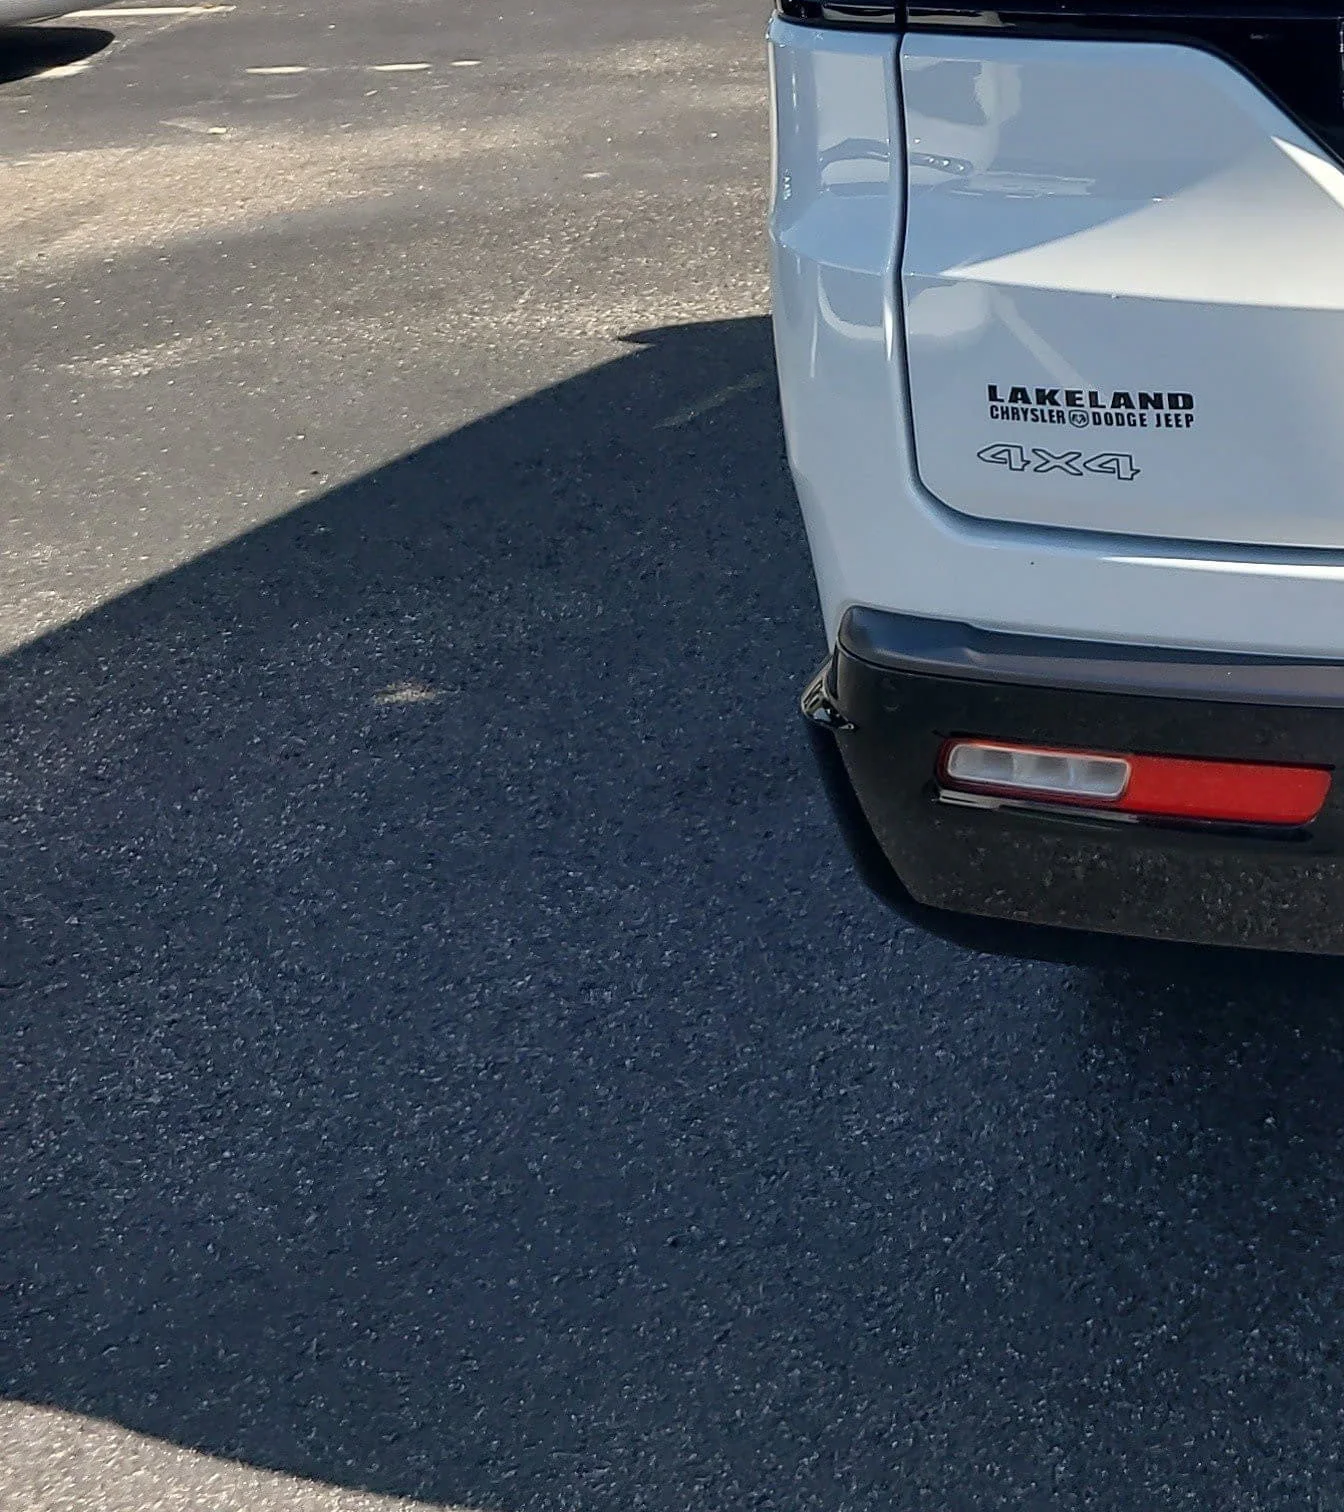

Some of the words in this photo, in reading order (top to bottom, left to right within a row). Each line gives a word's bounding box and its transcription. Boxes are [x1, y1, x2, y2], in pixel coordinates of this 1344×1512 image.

[987, 384, 1195, 411] LAKELAND
[990, 405, 1067, 425] CHRYSLER
[1092, 410, 1148, 428] DODGE
[1155, 411, 1195, 429] JEEP
